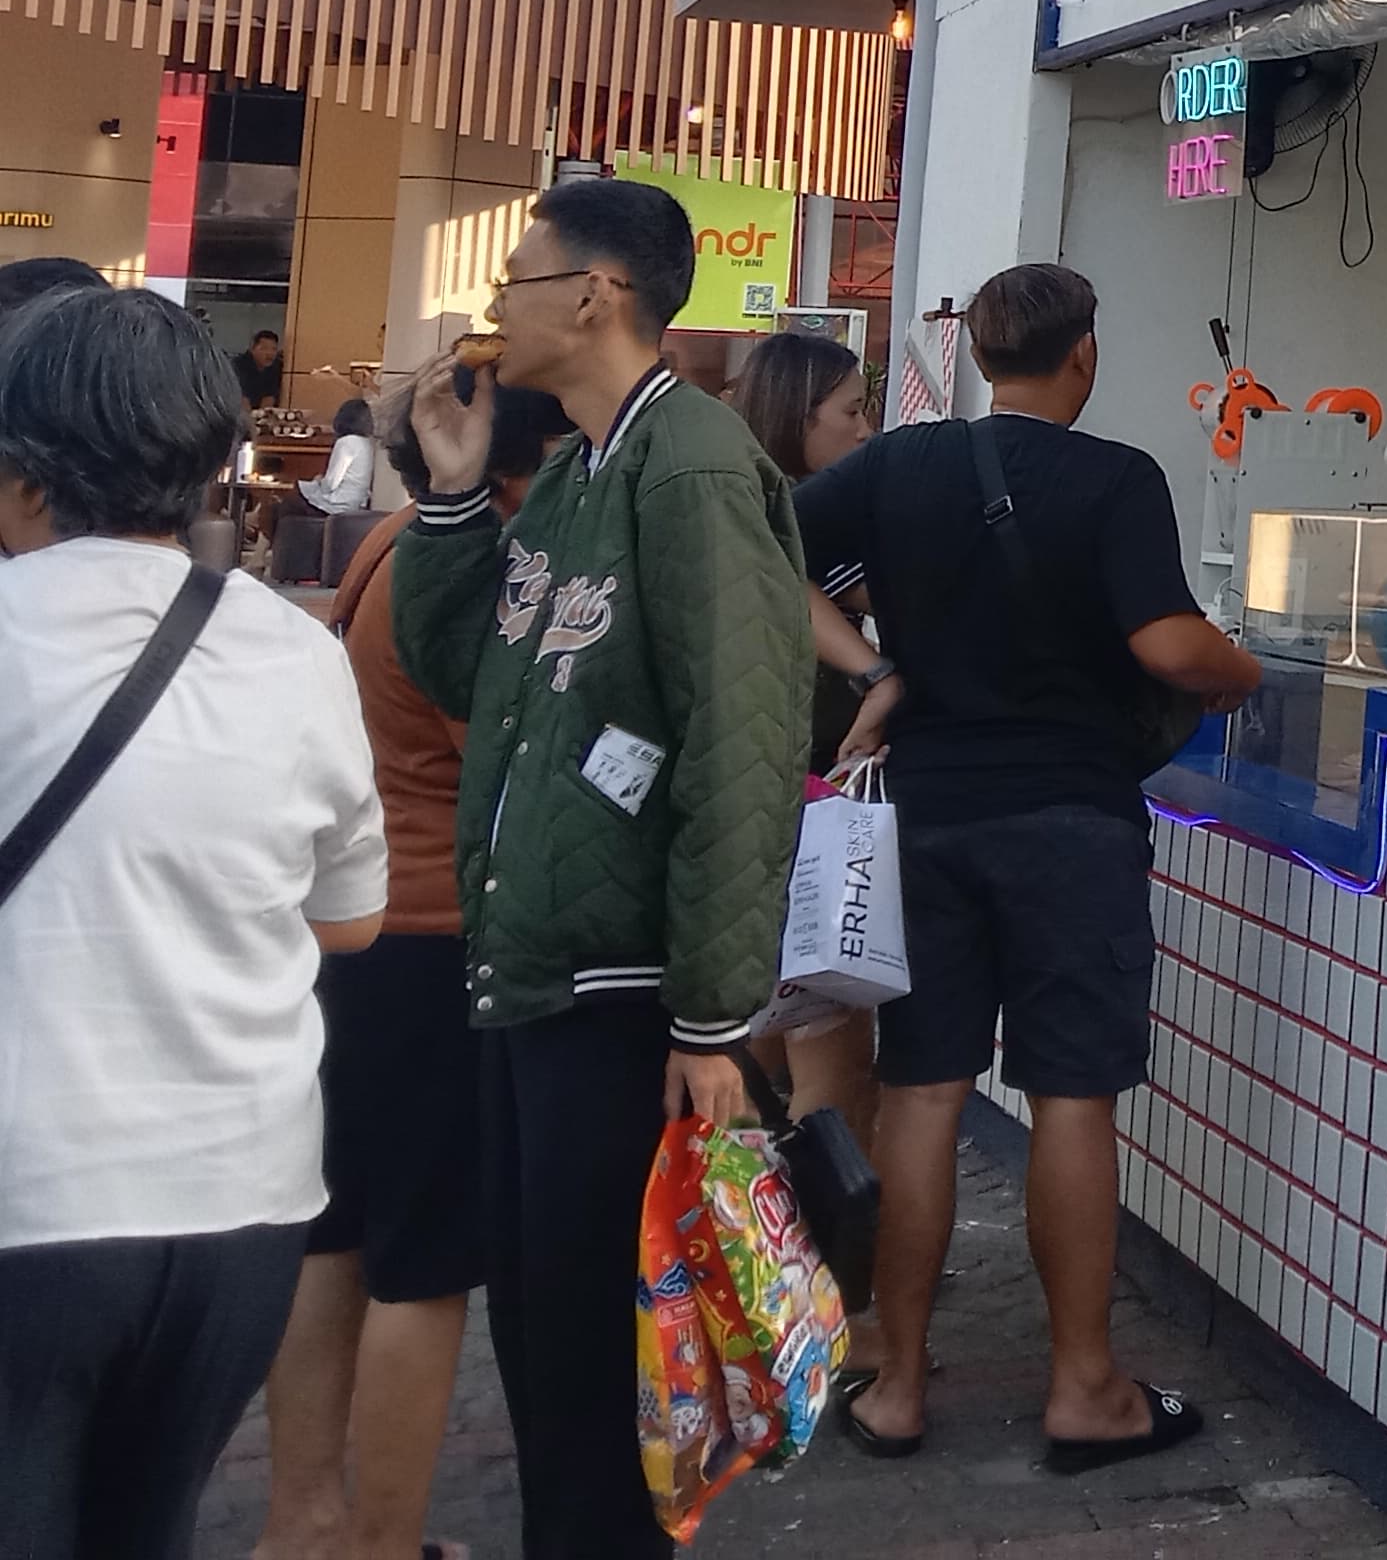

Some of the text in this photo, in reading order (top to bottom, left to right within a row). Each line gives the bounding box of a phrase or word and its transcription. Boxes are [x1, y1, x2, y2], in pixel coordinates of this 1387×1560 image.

[1160, 57, 1247, 125] ORDER
[1168, 133, 1234, 199] HERE
[0, 212, 54, 228] rimu
[695, 223, 777, 257] ndr
[846, 819, 860, 857] SKIN
[860, 810, 875, 855] CARE
[840, 855, 874, 961] ERHA
